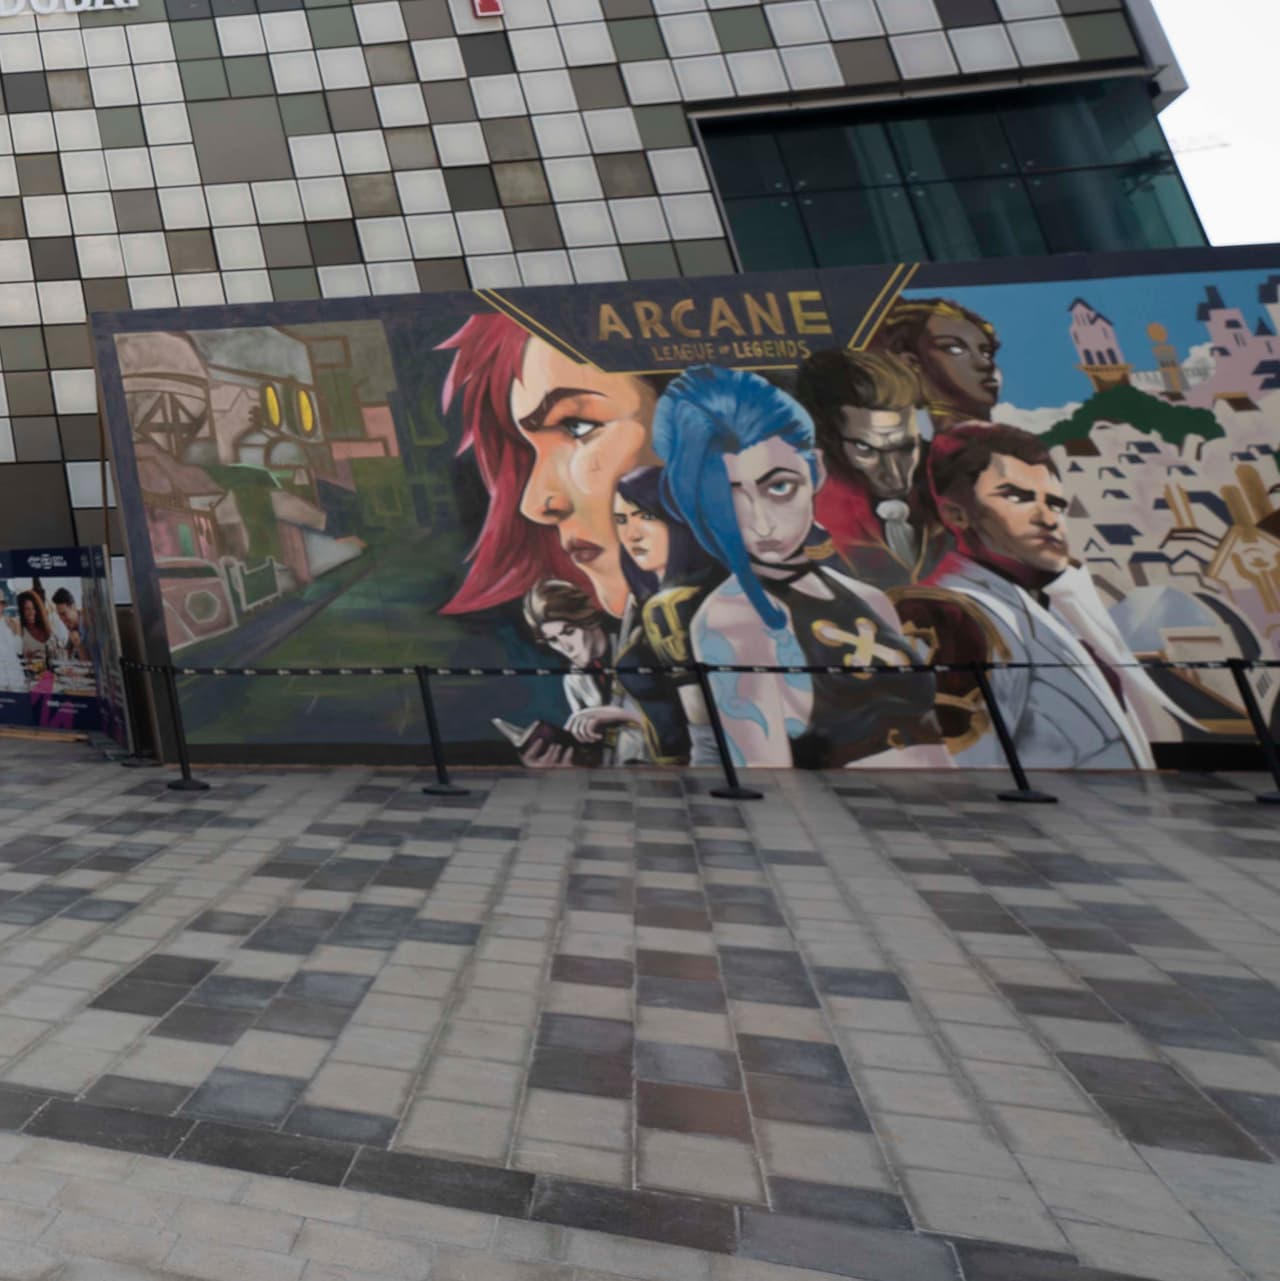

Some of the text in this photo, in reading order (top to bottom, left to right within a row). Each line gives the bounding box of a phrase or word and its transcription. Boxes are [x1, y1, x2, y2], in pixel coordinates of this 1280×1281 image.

[598, 290, 832, 341] ARCANE
[651, 343, 717, 361] LEAGUE
[732, 339, 812, 360] LEGENDS
